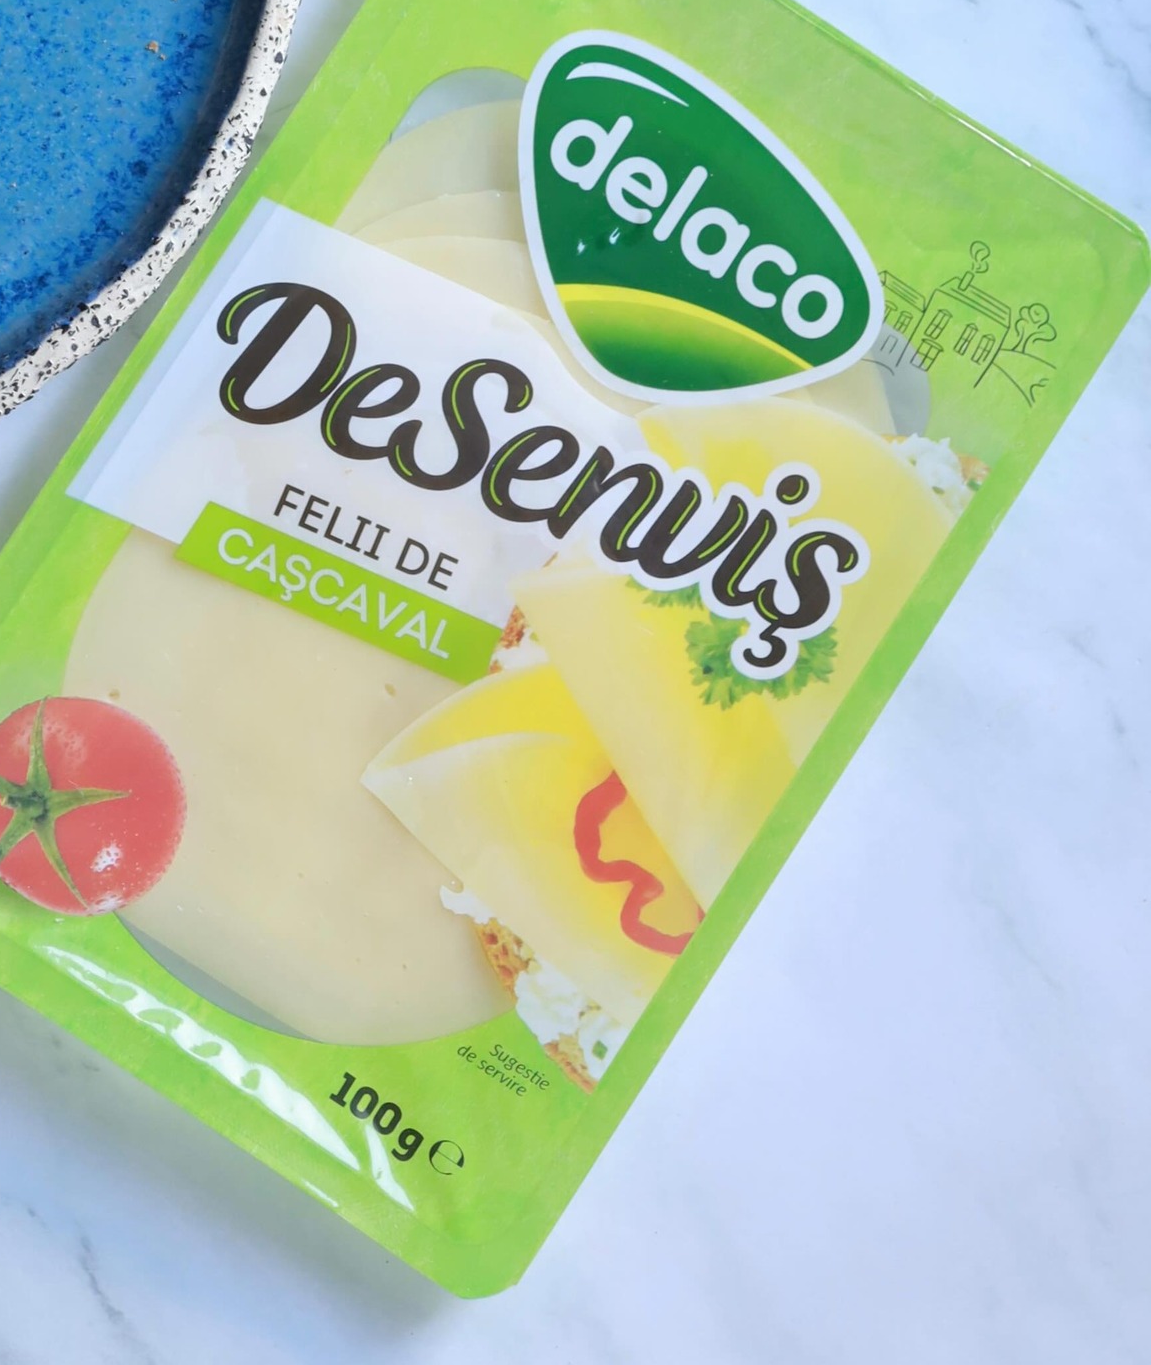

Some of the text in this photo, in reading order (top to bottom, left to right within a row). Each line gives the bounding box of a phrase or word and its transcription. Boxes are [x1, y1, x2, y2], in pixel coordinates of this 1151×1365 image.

[550, 115, 844, 339] delaco
[273, 483, 459, 591] FELII DE
[217, 528, 449, 660] CAŞCAVAL
[457, 1045, 527, 1097] de servire
[489, 1044, 550, 1091] Sugestie
